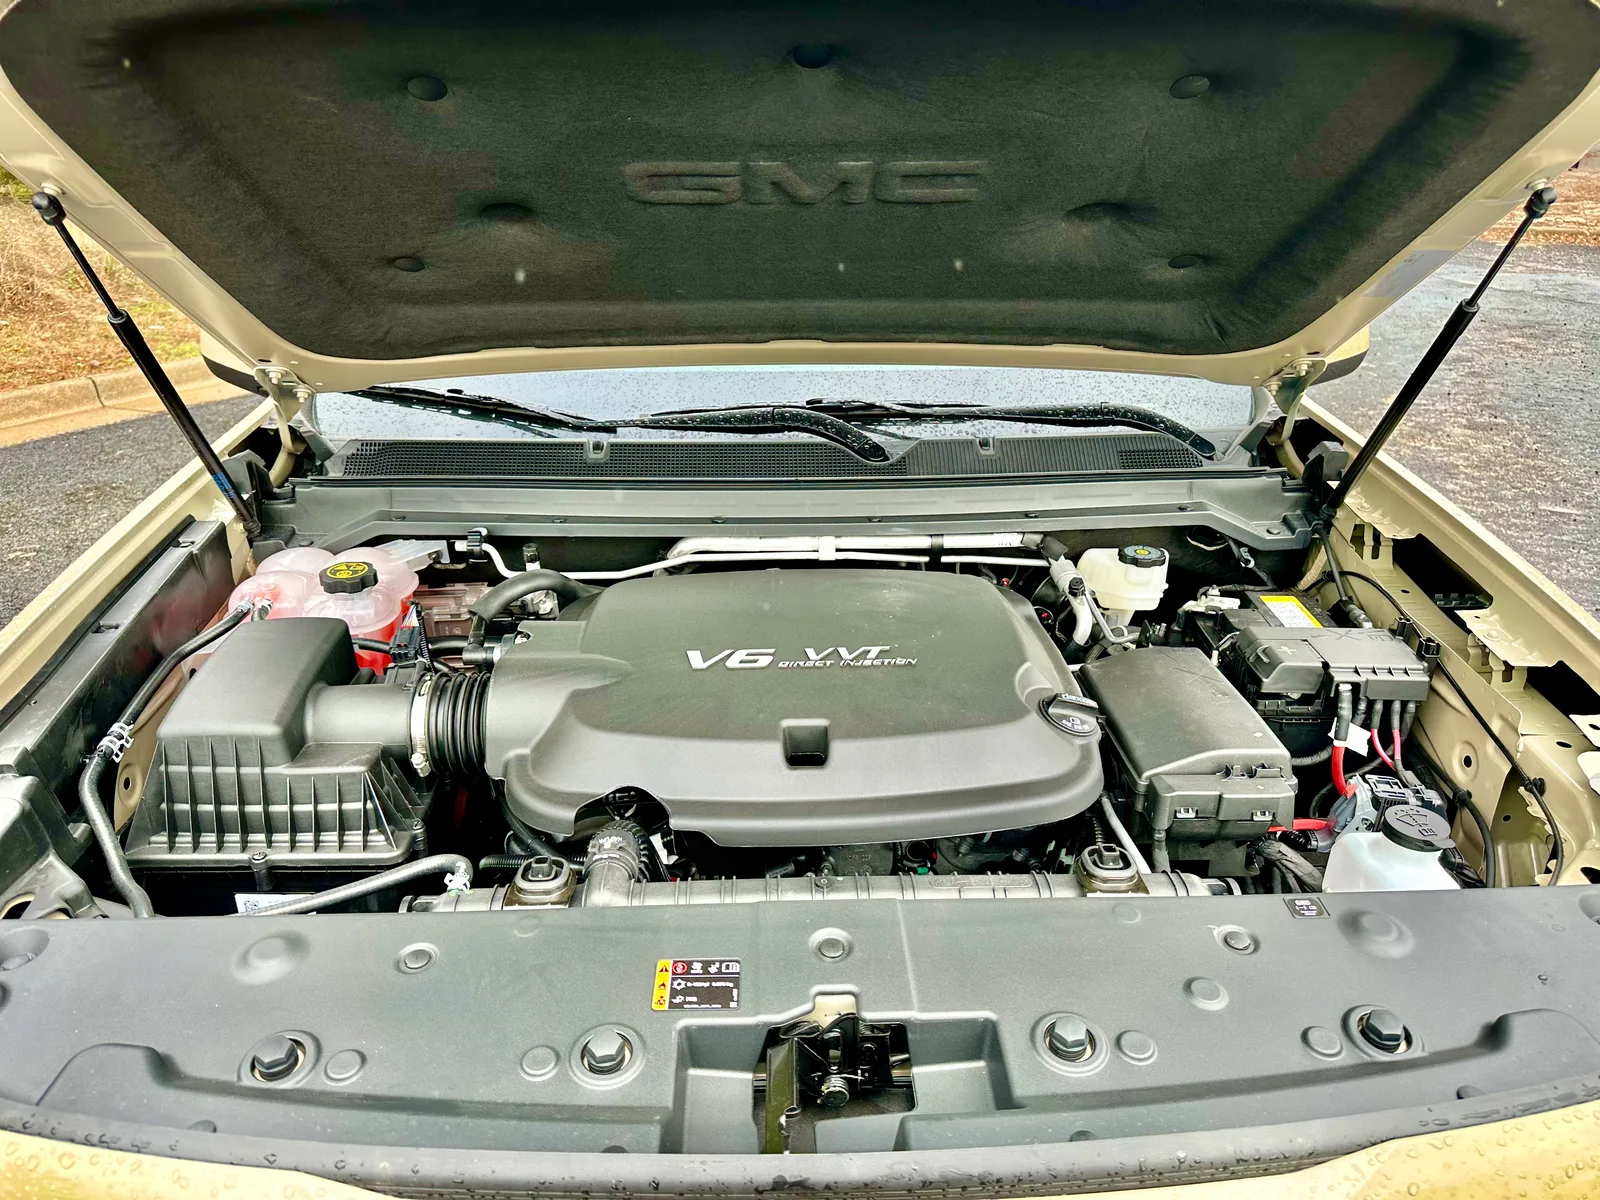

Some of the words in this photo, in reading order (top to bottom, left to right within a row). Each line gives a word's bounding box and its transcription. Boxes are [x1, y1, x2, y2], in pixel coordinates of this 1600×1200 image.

[622, 160, 988, 205] GMC
[686, 648, 776, 670] V6
[804, 645, 891, 661] VVT
[777, 659, 835, 669] DIRECT
[839, 657, 918, 667] INJECTION
